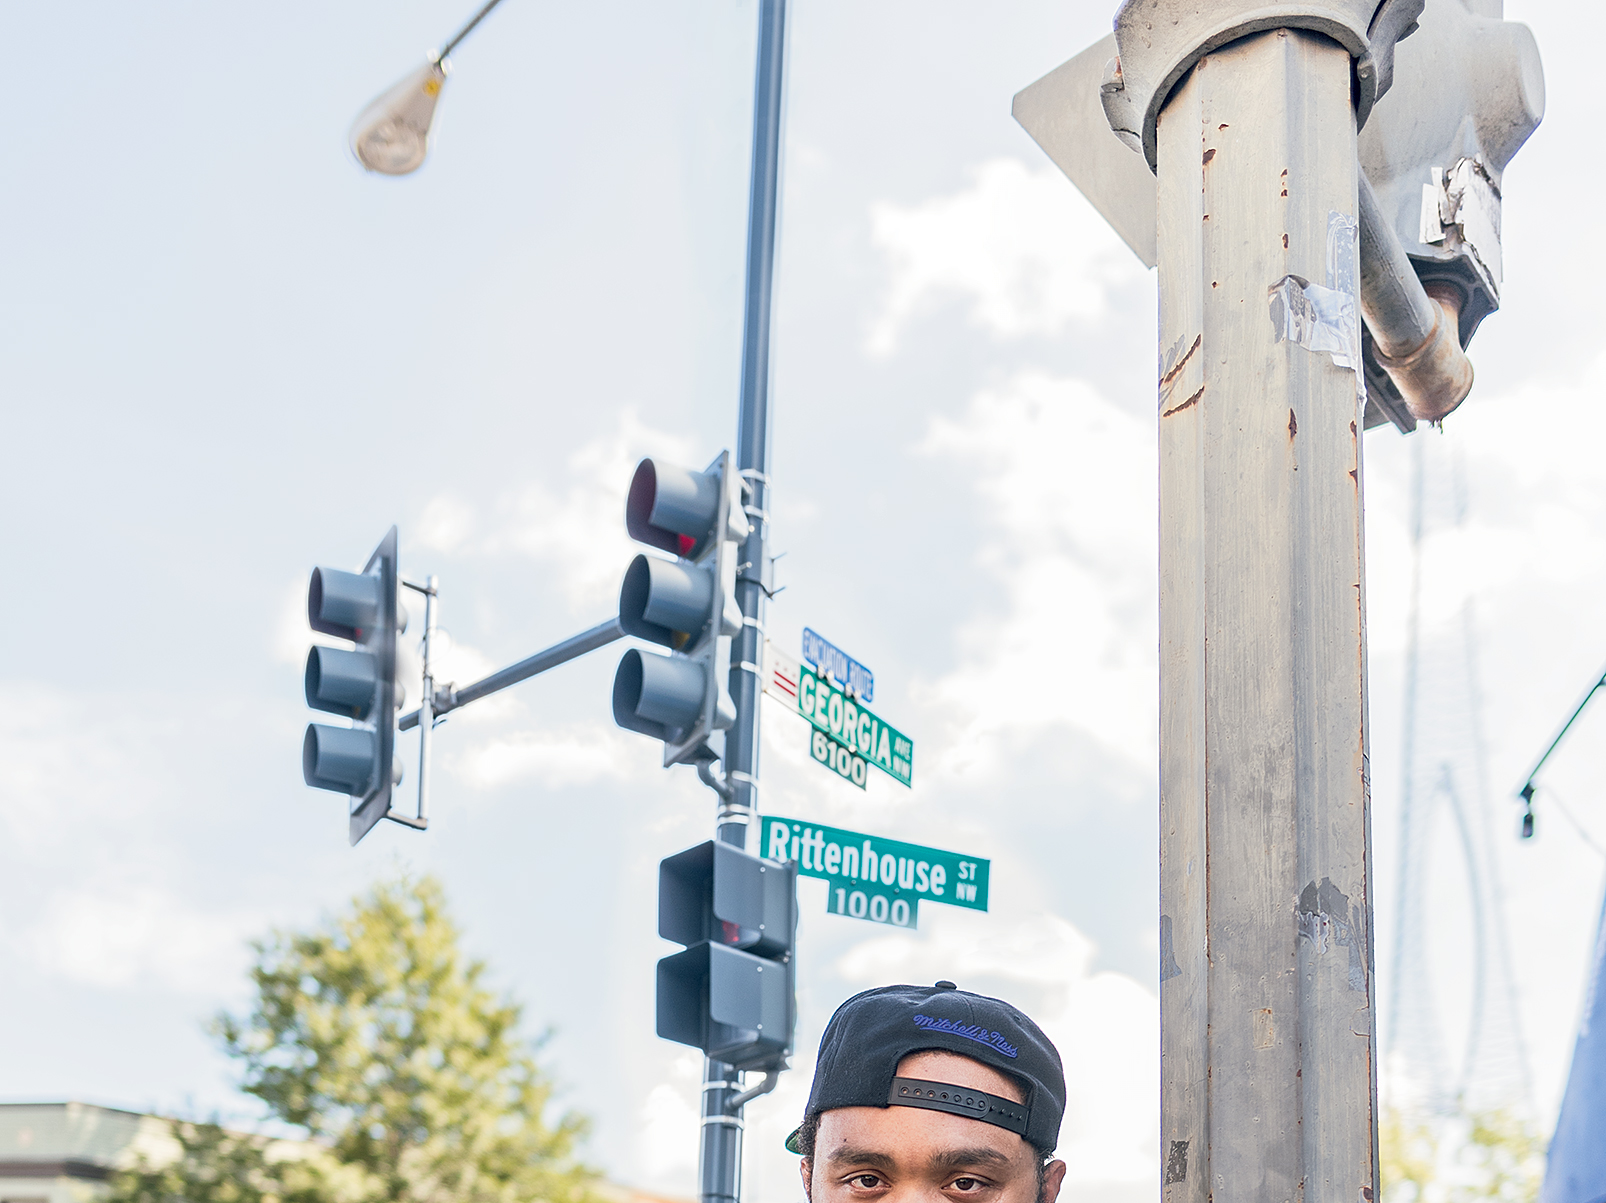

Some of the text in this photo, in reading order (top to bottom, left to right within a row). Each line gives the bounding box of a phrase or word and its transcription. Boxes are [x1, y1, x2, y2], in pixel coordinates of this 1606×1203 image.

[801, 673, 892, 769] GEORGIA
[812, 731, 866, 786] 6100
[893, 755, 911, 779] NW
[768, 821, 947, 896] Rittenhouse
[958, 860, 978, 881] ST
[835, 888, 910, 927] 1000
[956, 881, 978, 902] NW
[913, 1014, 1018, 1058] Mitchell & Ness
